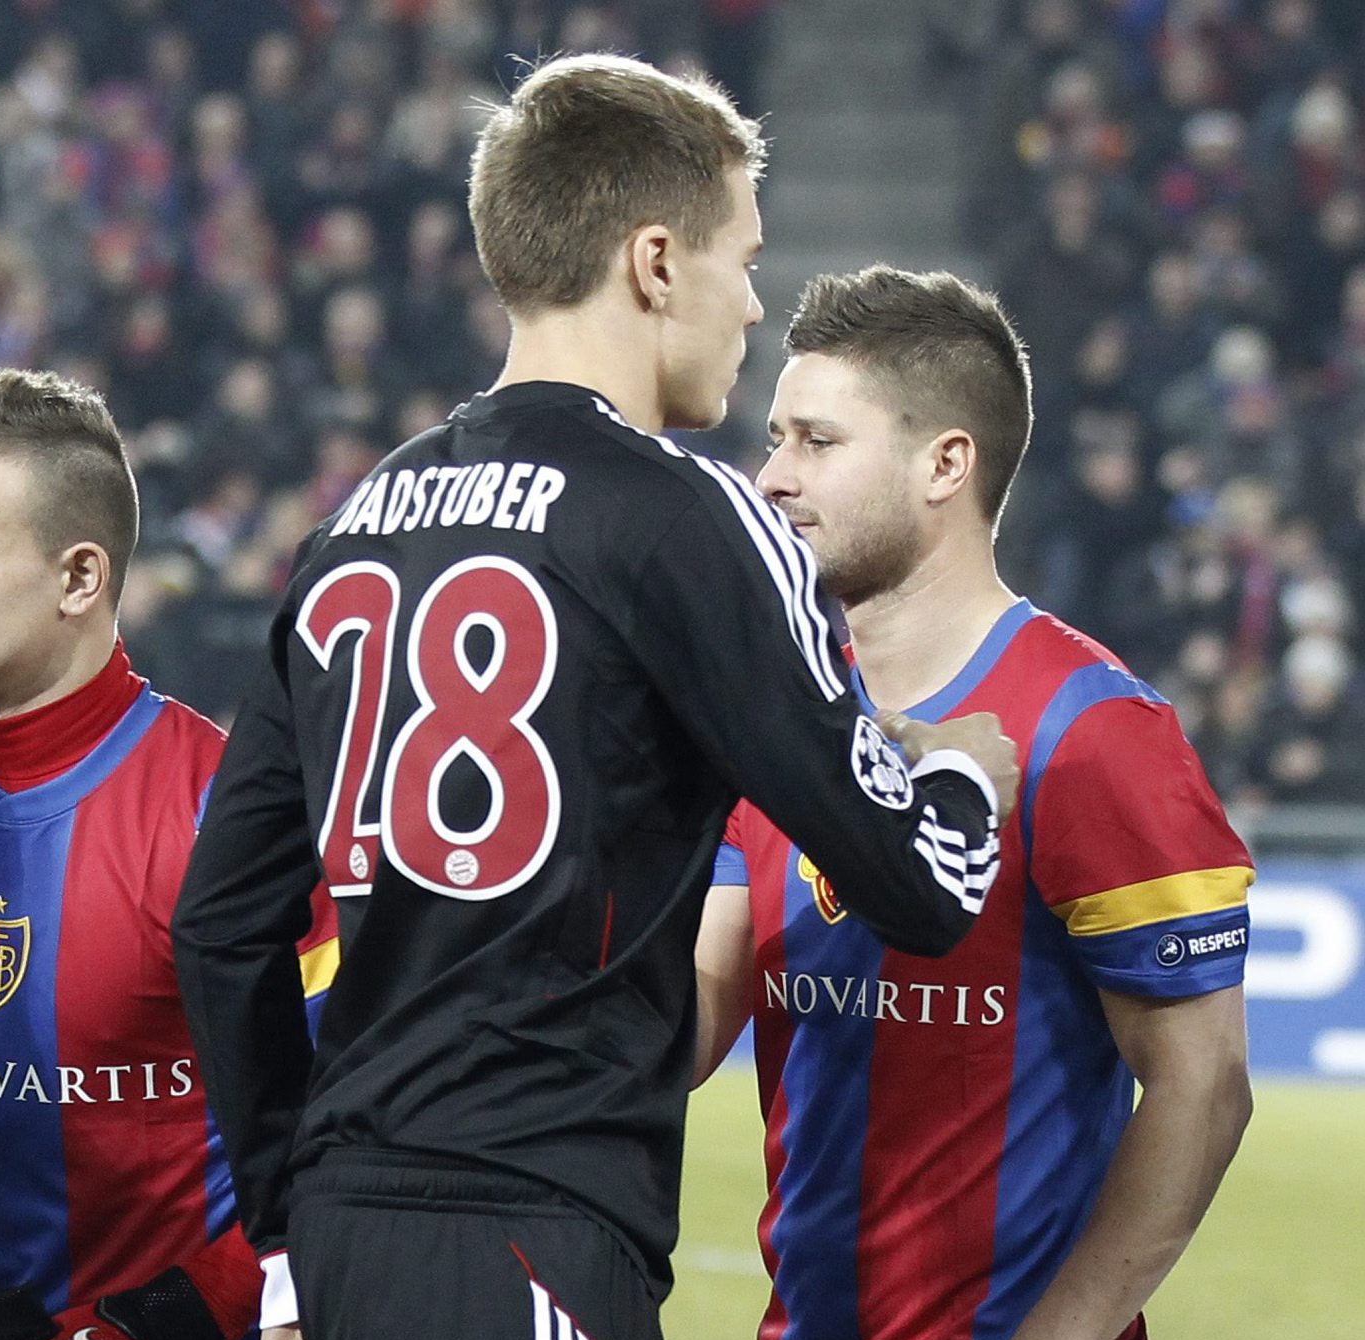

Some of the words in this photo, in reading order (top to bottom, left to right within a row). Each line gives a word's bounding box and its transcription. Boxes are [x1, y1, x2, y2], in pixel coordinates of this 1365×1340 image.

[329, 462, 566, 537] BADSTUBER
[295, 555, 562, 901] 28
[1188, 927, 1247, 956] RESPECT
[763, 969, 1006, 1026] NOVARTIS
